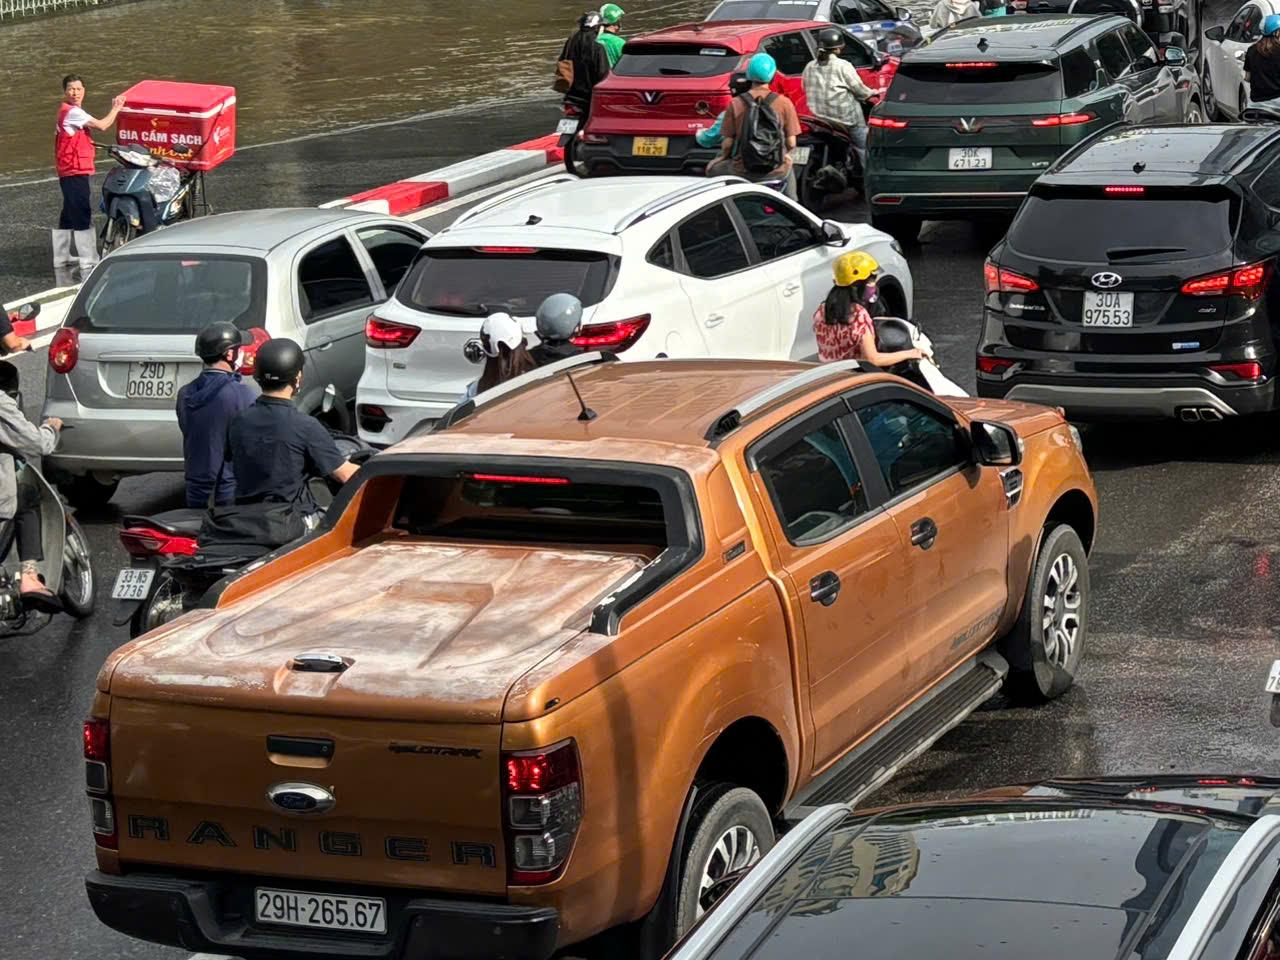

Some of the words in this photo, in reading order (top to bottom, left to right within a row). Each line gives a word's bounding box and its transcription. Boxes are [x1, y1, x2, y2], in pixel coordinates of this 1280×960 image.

[119, 129, 138, 141] GIA
[1095, 292, 1121, 308] 30A
[1085, 309, 1131, 326] 975.53
[139, 361, 166, 379] 29D
[129, 380, 174, 397] 008.83
[127, 813, 497, 868] RANGER
